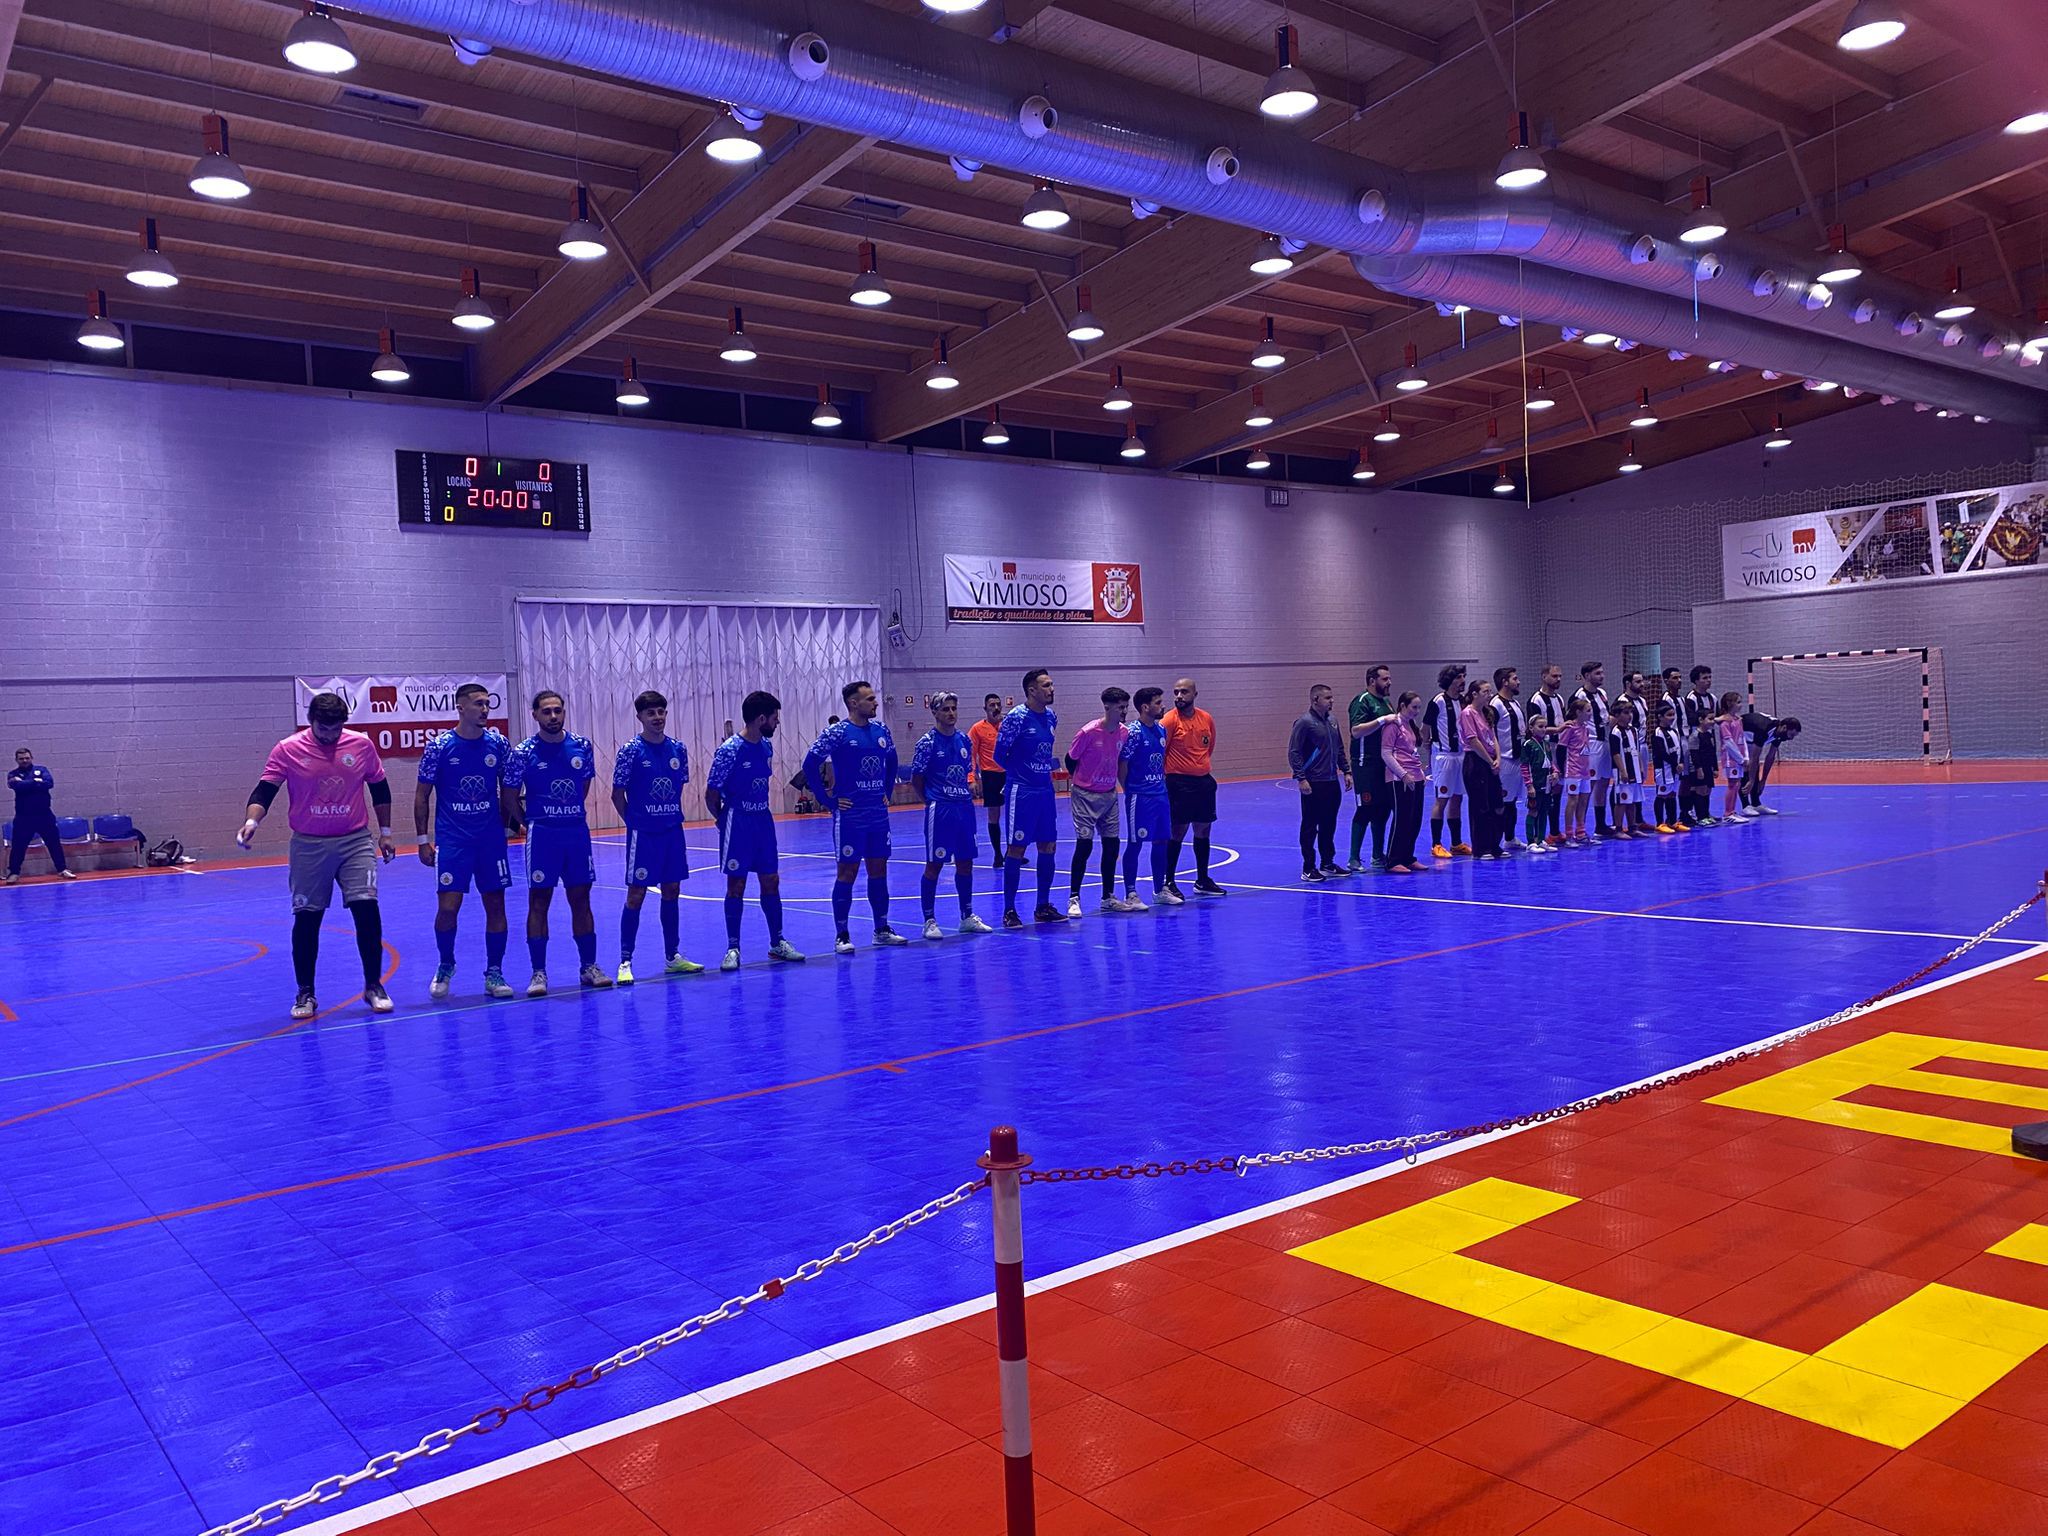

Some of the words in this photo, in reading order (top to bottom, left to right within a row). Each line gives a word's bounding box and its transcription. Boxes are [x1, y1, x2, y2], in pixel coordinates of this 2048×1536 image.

[466, 458, 477, 476] 0
[539, 463, 550, 480] 0
[446, 476, 472, 487] LOCAIS
[515, 480, 552, 492] VISITANTES
[444, 506, 454, 521] 0
[542, 512, 551, 526] 0
[1057, 572, 1066, 582] de
[1742, 565, 1817, 587] VIMIOSO
[970, 582, 1067, 606] VIMIOSO
[953, 608, 996, 620] tradição
[1004, 610, 1052, 621] qualidade
[1053, 610, 1065, 620] de
[404, 682, 450, 694] município
[856, 780, 872, 788] VILA
[310, 805, 330, 814] VILA
[452, 803, 472, 812] VILA
[544, 806, 563, 814] VILA
[646, 804, 663, 812] VILA
